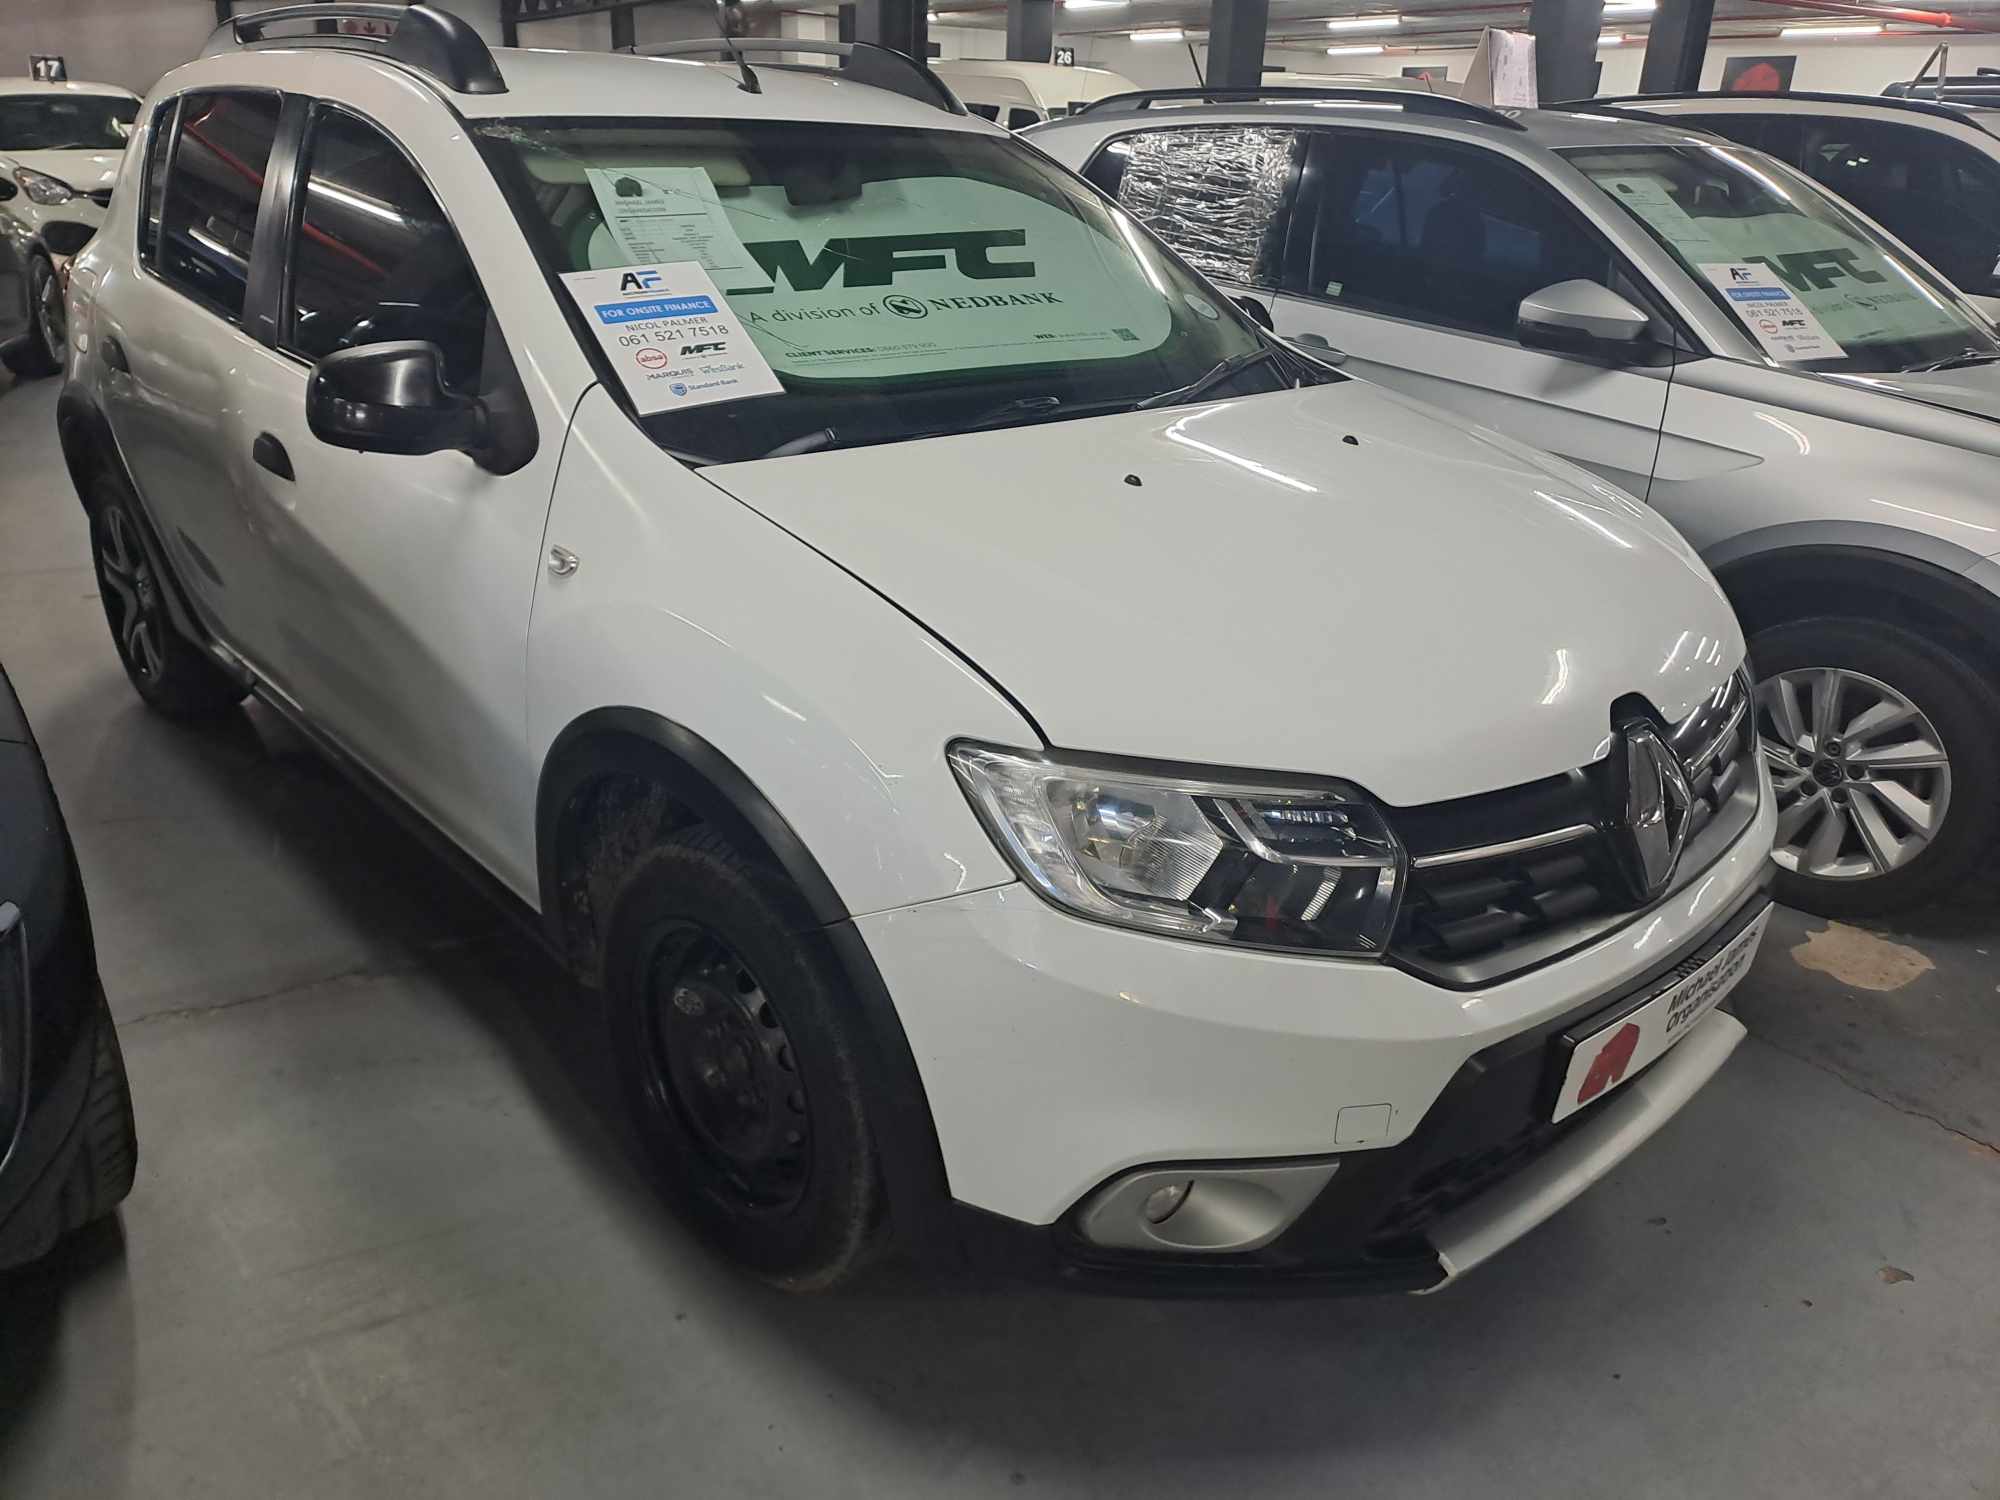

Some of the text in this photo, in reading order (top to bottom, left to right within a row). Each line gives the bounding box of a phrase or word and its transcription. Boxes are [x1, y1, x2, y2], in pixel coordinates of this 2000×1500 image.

[1056, 50, 1073, 65] 26
[36, 59, 60, 77] 17
[726, 229, 1036, 296] MFC
[620, 269, 663, 291] AF
[602, 300, 712, 319] FOR ONSITE FINANCE
[750, 292, 1063, 323] A division of NEDBANK
[625, 317, 709, 332] NICOL PALMER
[618, 325, 729, 347] 061 521 7518
[680, 341, 727, 355] MFC
